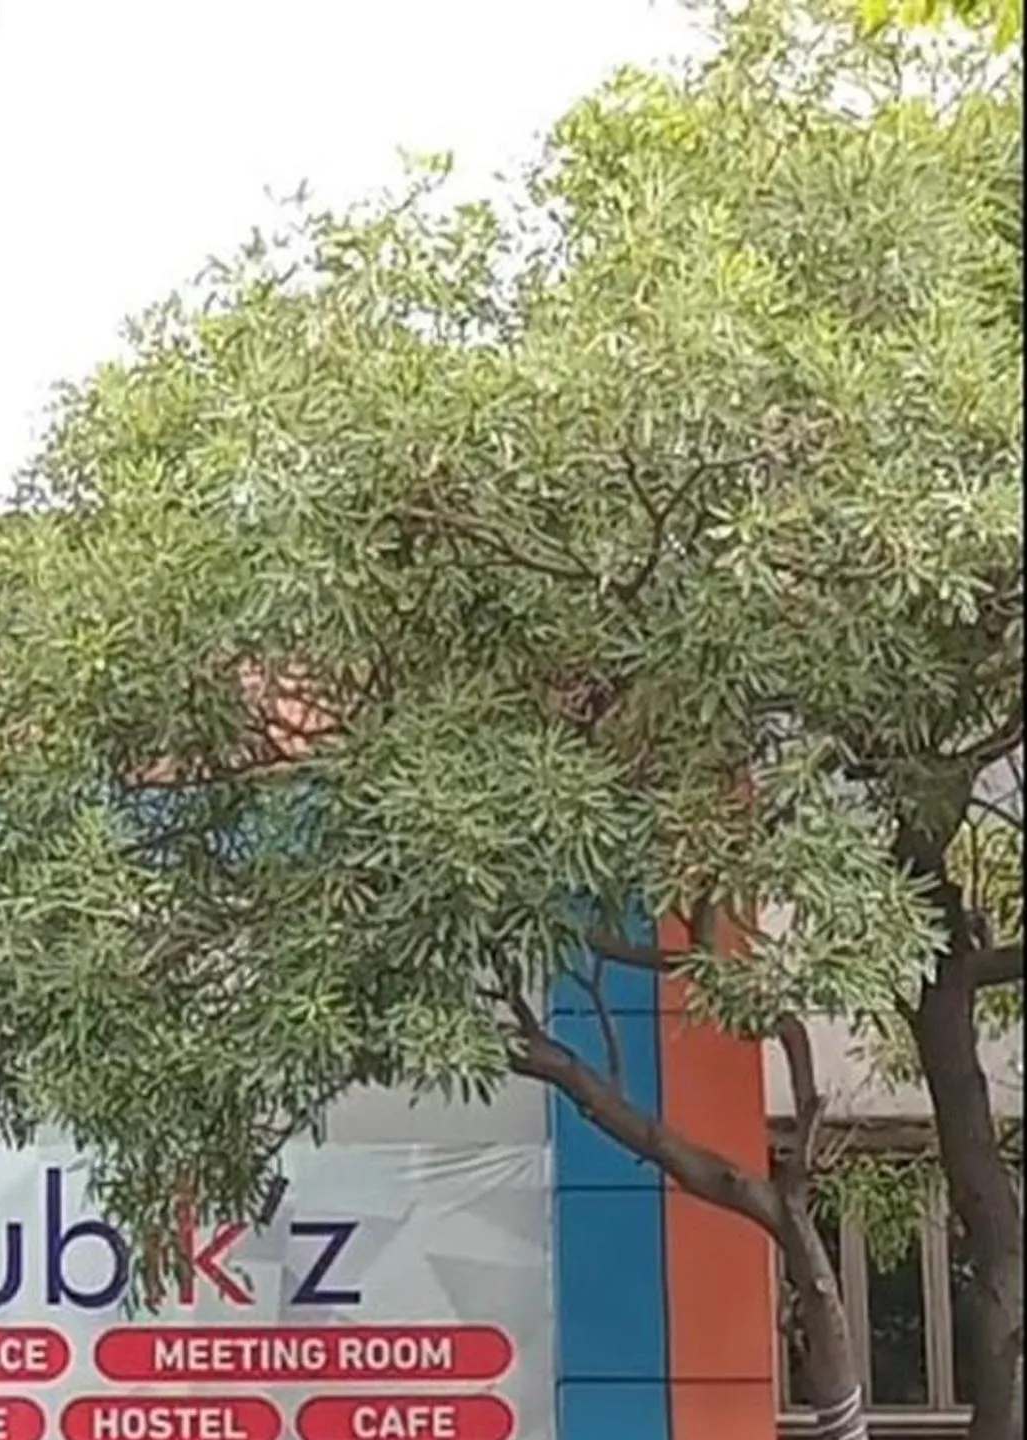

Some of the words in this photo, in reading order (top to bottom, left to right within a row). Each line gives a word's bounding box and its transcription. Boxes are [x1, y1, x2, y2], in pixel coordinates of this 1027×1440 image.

[153, 1338, 327, 1370] MEETING
[337, 1338, 453, 1370] ROOM
[92, 1408, 247, 1440] HOSTEL
[353, 1407, 455, 1438] CAFE
